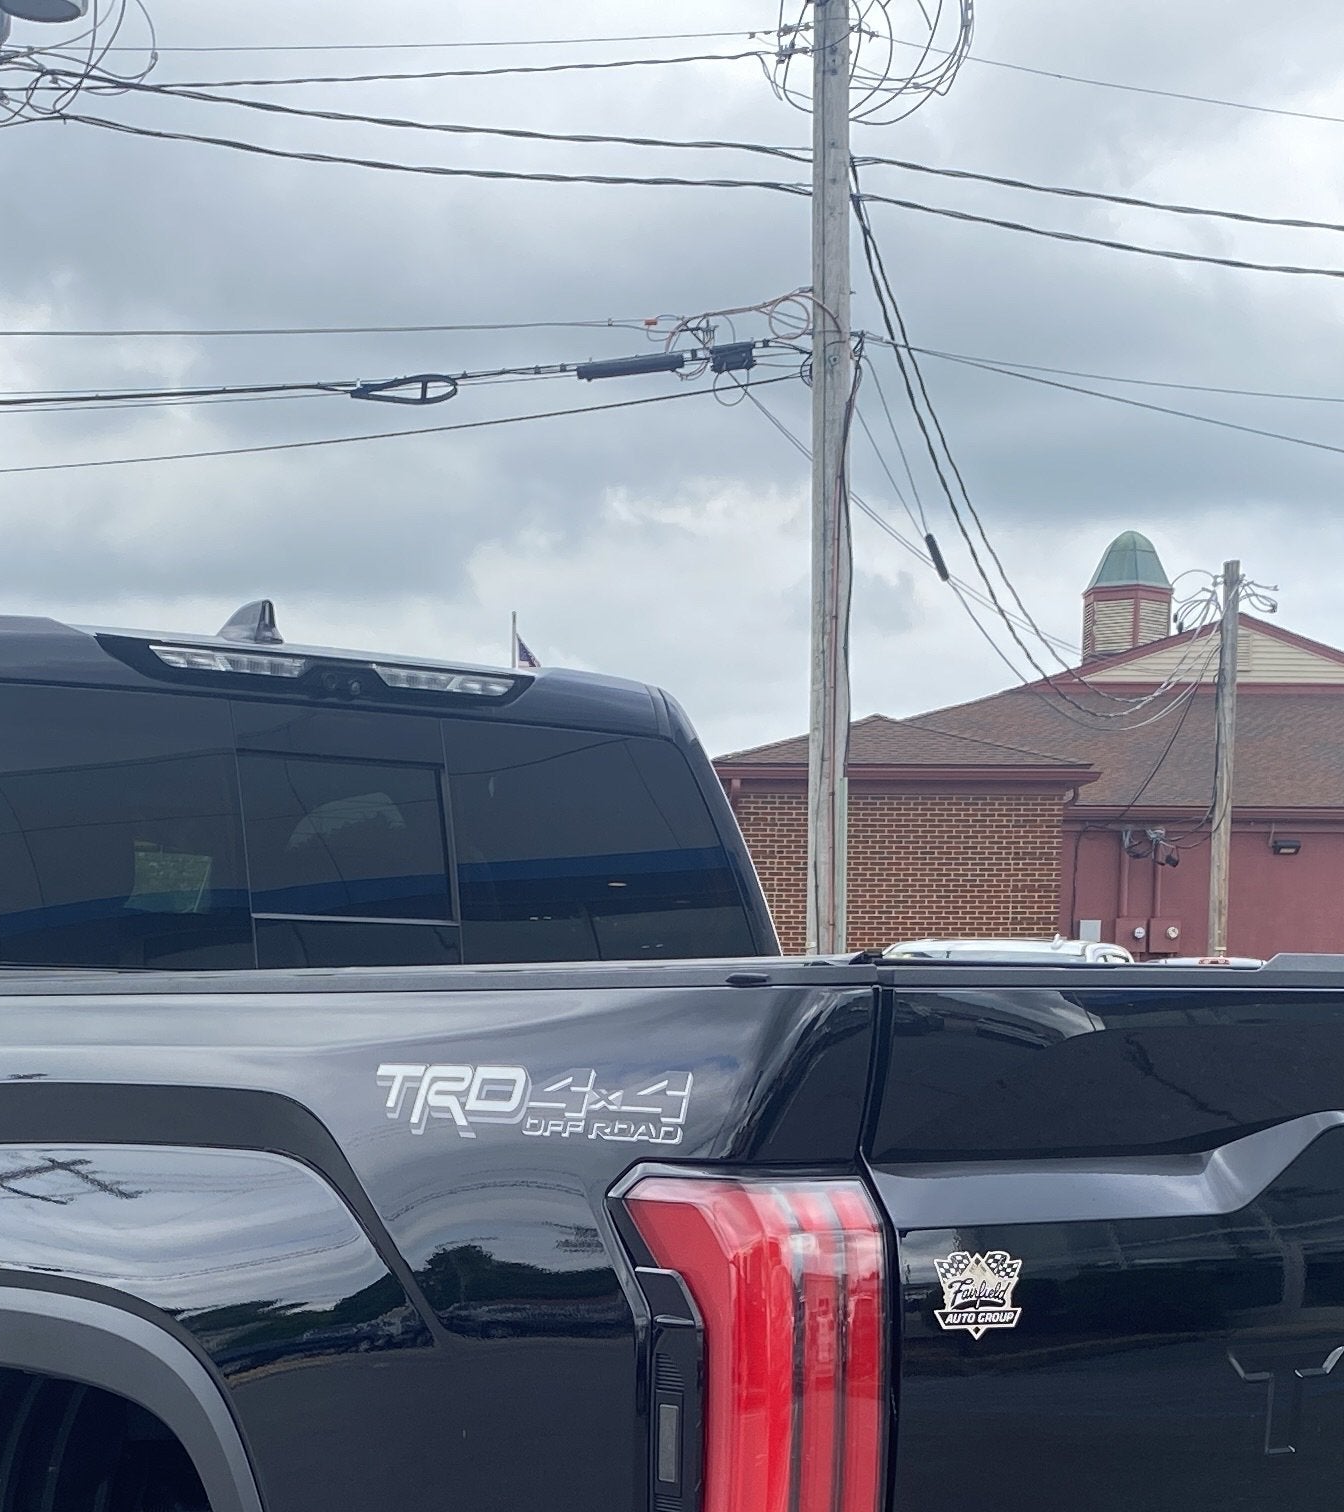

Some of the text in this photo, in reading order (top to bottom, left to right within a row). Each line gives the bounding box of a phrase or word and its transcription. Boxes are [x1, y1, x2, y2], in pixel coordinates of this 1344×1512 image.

[376, 1064, 532, 1139] TRD
[521, 1115, 684, 1145] OFF ROAD
[947, 1277, 1012, 1310] Fairfield
[944, 1312, 1016, 1324] AUTO GROUP
